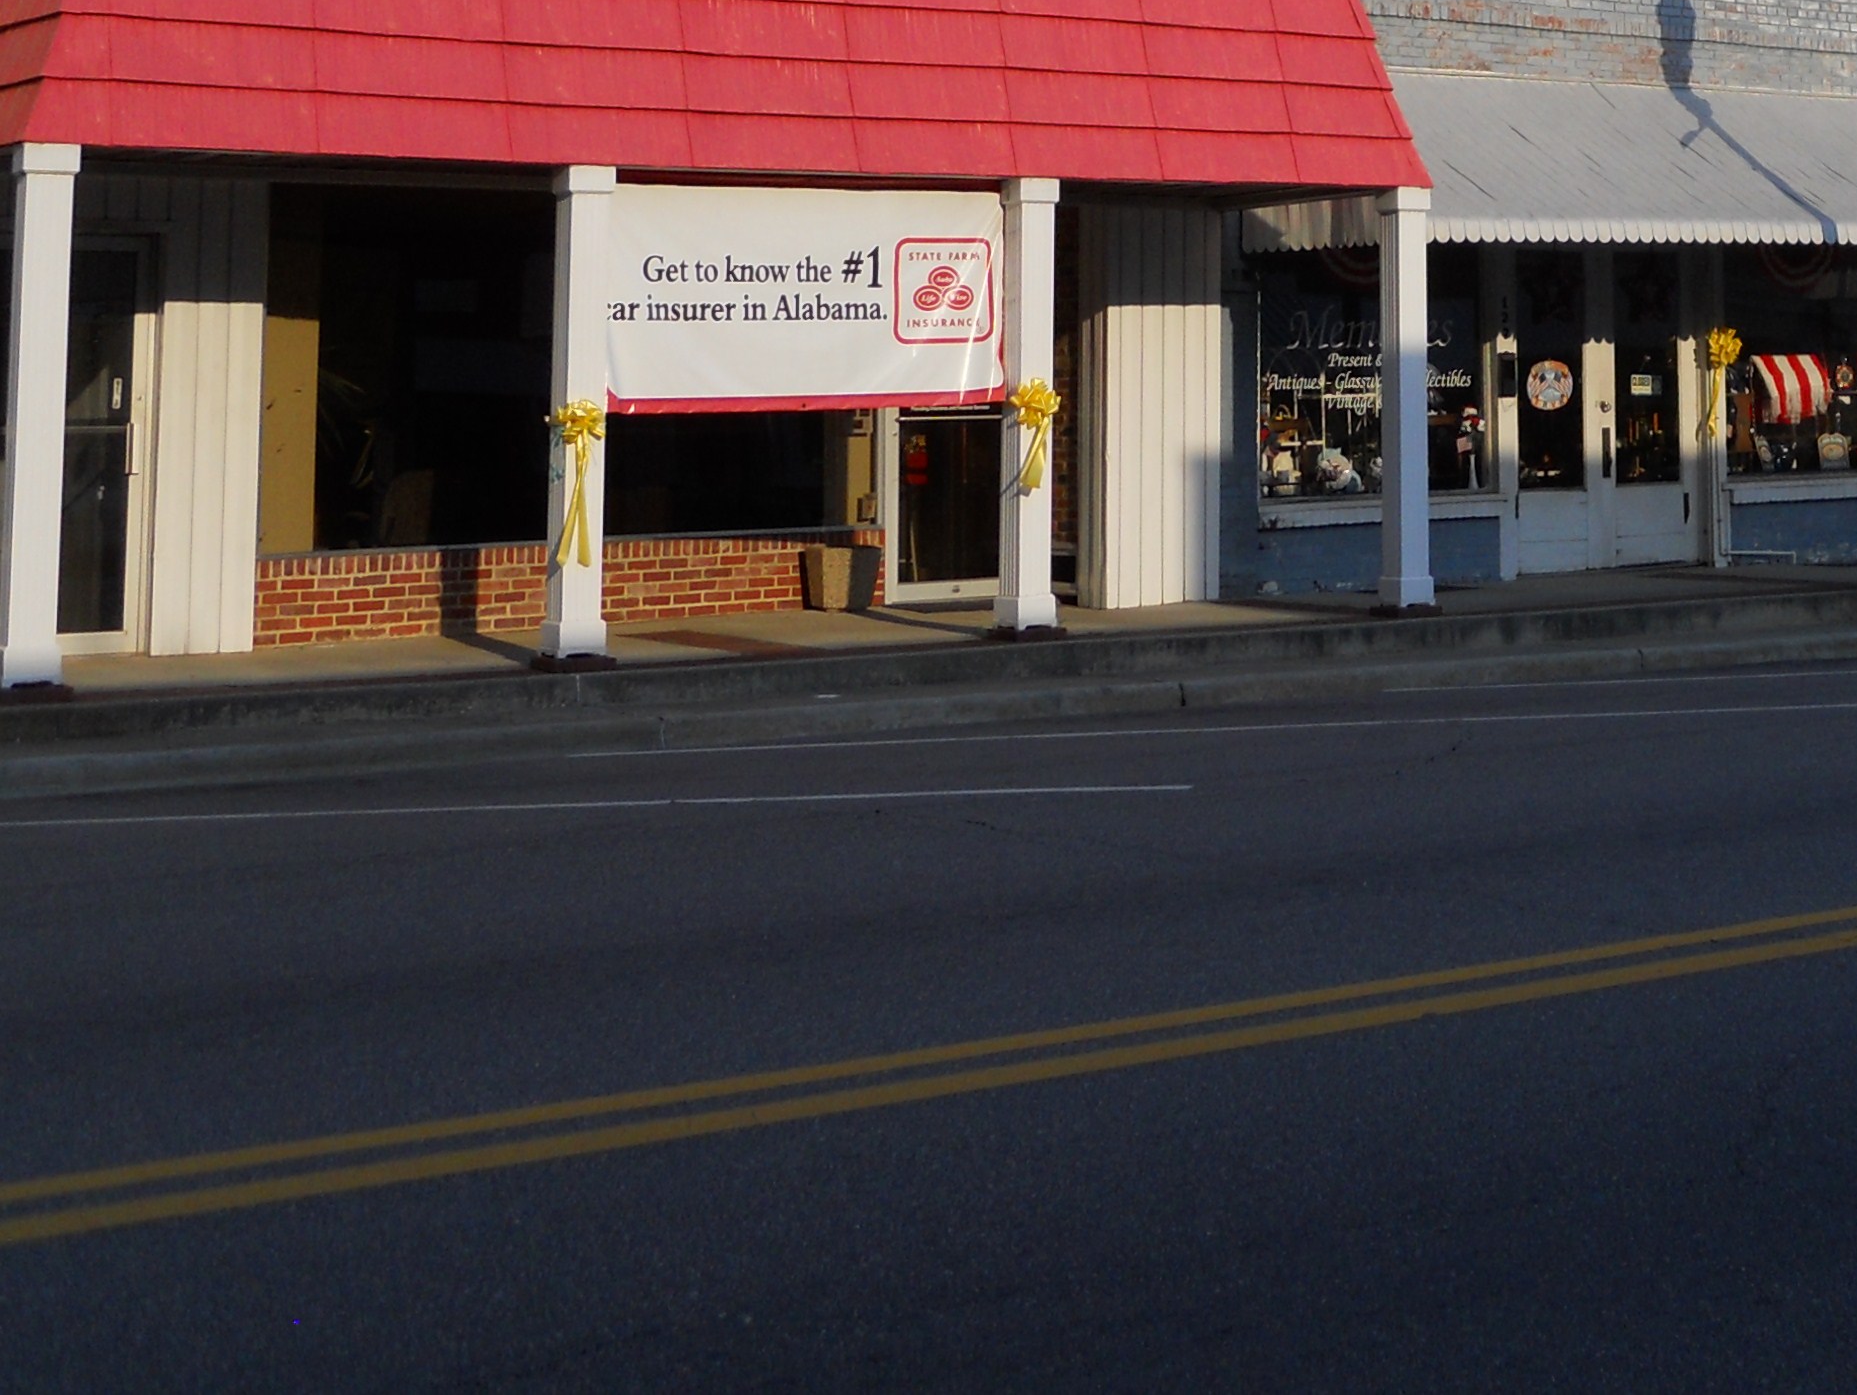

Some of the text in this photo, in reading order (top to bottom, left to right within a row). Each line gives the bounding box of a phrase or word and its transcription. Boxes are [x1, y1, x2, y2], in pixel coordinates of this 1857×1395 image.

[642, 246, 883, 288] Get to know the #1
[908, 252, 980, 261] STATE FARM
[647, 294, 736, 321] insurer
[742, 294, 768, 321] in
[772, 293, 888, 321] Alabama.
[1327, 352, 1372, 367] Present
[1266, 373, 1324, 397] Antiques
